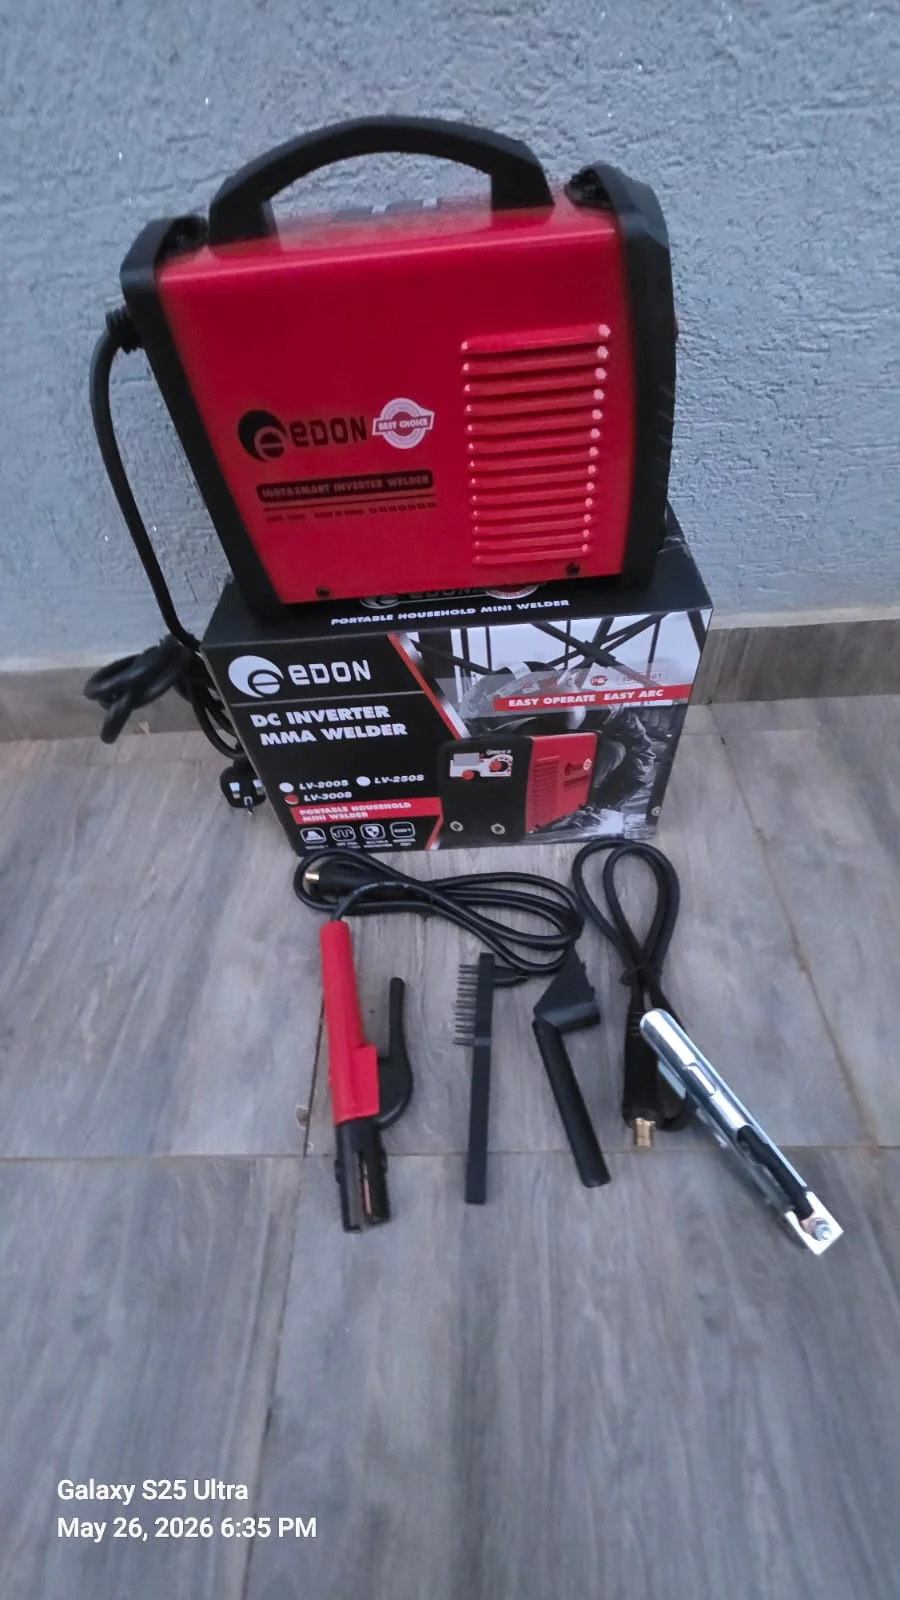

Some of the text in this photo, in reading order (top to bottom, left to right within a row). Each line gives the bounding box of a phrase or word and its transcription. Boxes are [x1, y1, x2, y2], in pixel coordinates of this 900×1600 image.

[378, 417, 429, 431] BEST CHOICE
[333, 479, 383, 493] INVERTER
[386, 474, 430, 488] WELDER
[331, 599, 571, 626] PORTABLE HOUSEHOLD MINI WELDER
[508, 689, 665, 708] EASY OPERATE EASY ARC
[250, 705, 391, 728] DC INVERTER
[260, 723, 409, 746] MMA WELDER
[374, 774, 425, 785] LV-250S
[303, 791, 353, 802] LV-300S
[299, 802, 413, 816] PORTABLE HOUSEHOLD
[302, 811, 369, 823] MINI WELDER
